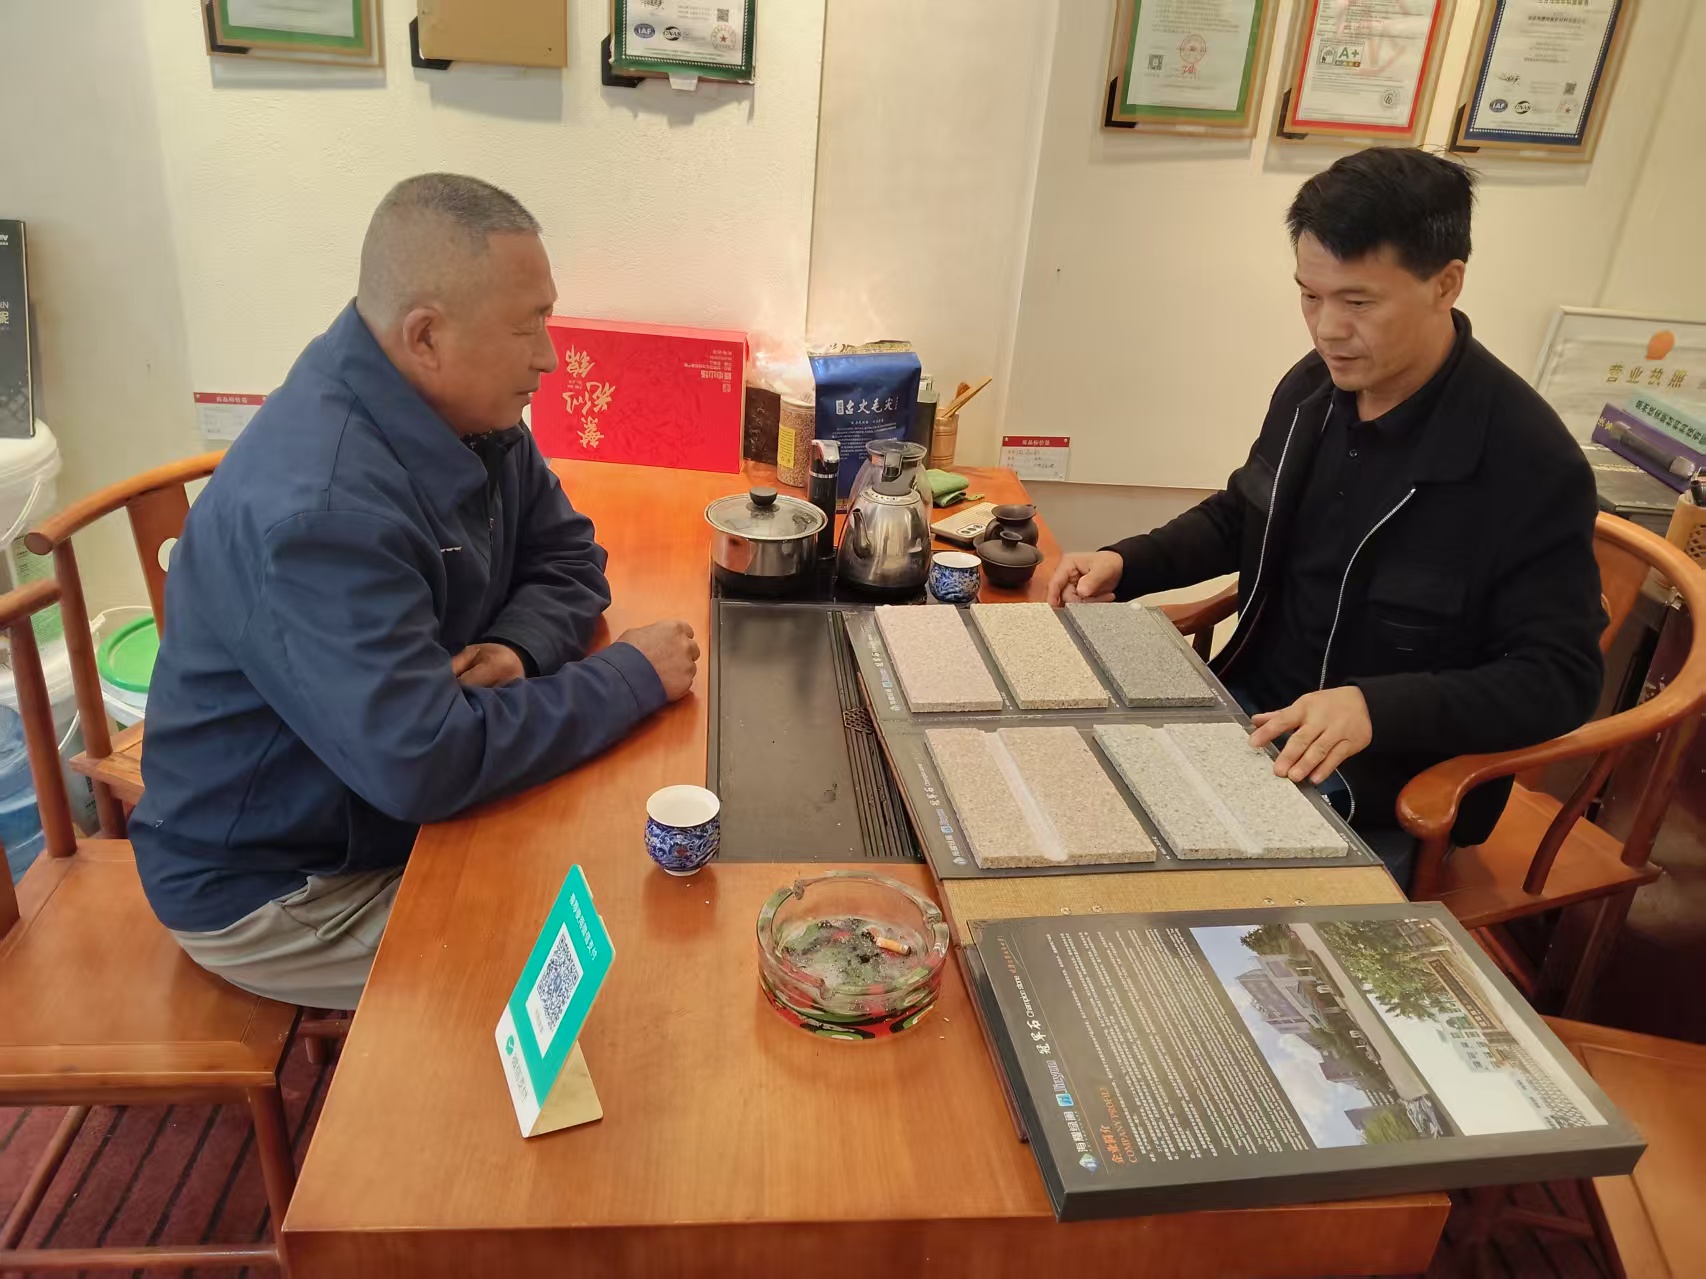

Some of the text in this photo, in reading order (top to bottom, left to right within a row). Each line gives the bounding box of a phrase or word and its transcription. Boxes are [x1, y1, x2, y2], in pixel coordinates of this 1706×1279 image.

[1339, 47, 1360, 59] A+
[1606, 362, 1688, 388] 营业执照
[1019, 991, 1035, 1018] Champion
[1113, 1120, 1138, 1164] COMPANY
